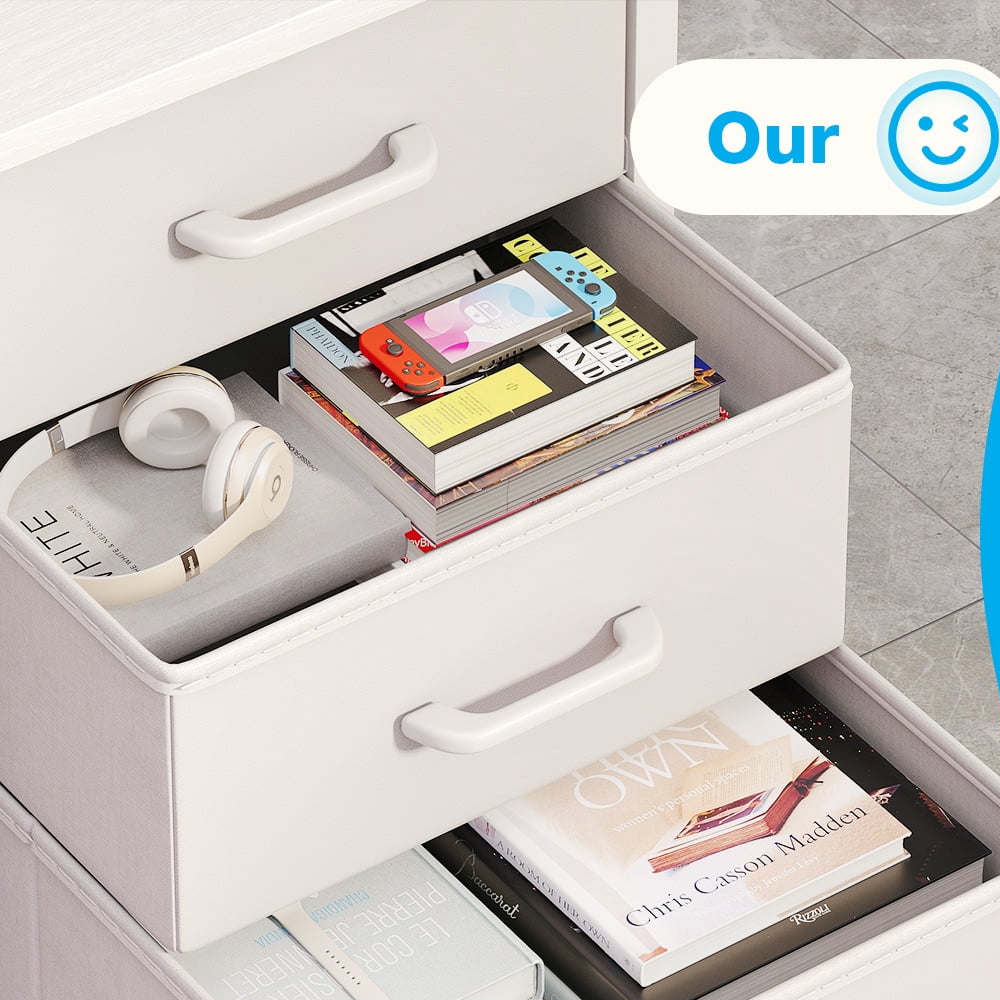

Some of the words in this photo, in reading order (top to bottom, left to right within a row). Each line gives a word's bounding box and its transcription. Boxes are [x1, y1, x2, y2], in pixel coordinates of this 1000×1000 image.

[305, 325, 349, 364] PHAIDON
[556, 341, 605, 379] AND
[20, 510, 113, 577] HITE
[574, 721, 729, 809] OWN
[612, 805, 665, 833] women's
[665, 780, 713, 811] personal
[715, 764, 752, 787] spaces
[454, 838, 521, 919] Baccarat
[507, 848, 540, 884] ROOM
[625, 893, 692, 927] Chris
[694, 853, 774, 894] Casson
[774, 806, 868, 856] Madden
[309, 889, 370, 923] CHANDIGA
[353, 880, 447, 936] PIERRE
[409, 916, 450, 947] LE
